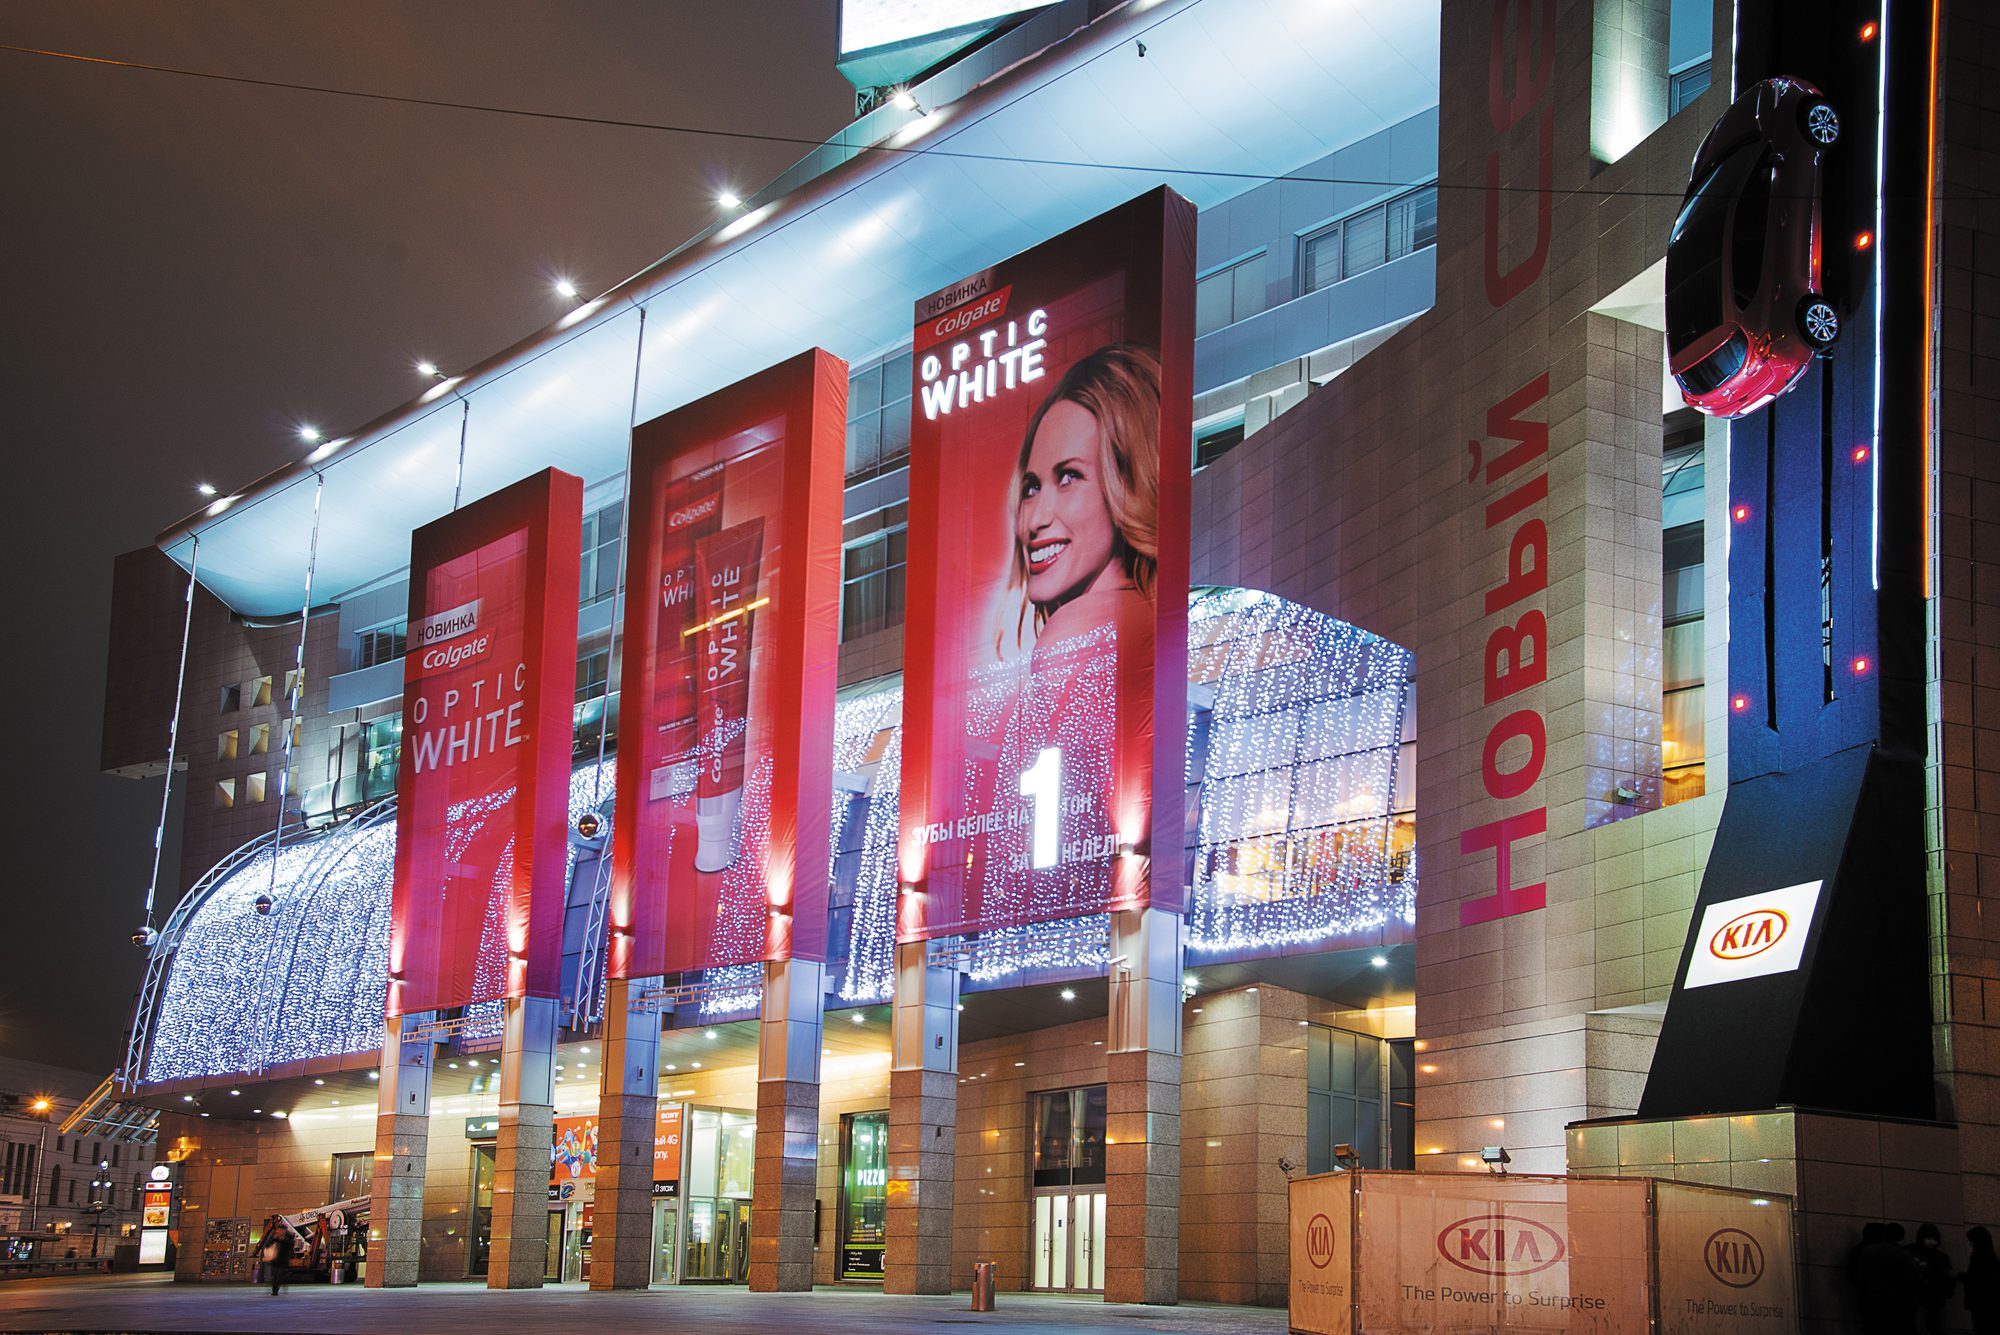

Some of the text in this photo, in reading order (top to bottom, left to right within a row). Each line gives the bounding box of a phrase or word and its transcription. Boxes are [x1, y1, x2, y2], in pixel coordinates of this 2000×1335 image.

[928, 277, 988, 315] НОВИНКА
[935, 296, 1001, 336] Colgate
[921, 308, 1048, 382] OPTIC
[921, 338, 1048, 420] WHITE
[418, 611, 476, 643] НОВИНКА
[707, 572, 722, 682] OPIC
[720, 565, 740, 678] WHTE
[423, 638, 488, 669] Colgate
[1460, 370, 1550, 929] Новый
[413, 662, 526, 725] OPTIC
[412, 699, 525, 774] WHITE
[1019, 746, 1062, 870] 1
[911, 820, 953, 848] ЗУБЫ
[957, 810, 1003, 838] БЕЛЕЕ
[1007, 807, 1030, 828] НА
[1009, 851, 1031, 873] ЗА
[1721, 918, 1774, 952] KIA
[667, 1134, 678, 1145] 4G
[1311, 1226, 1330, 1256] KIA
[1458, 1228, 1543, 1263] KIA
[1714, 1241, 1757, 1275] KIA
[1402, 1285, 1606, 1310] The Power to Surprise
[1685, 1299, 1783, 1319] The Power to Surprise
